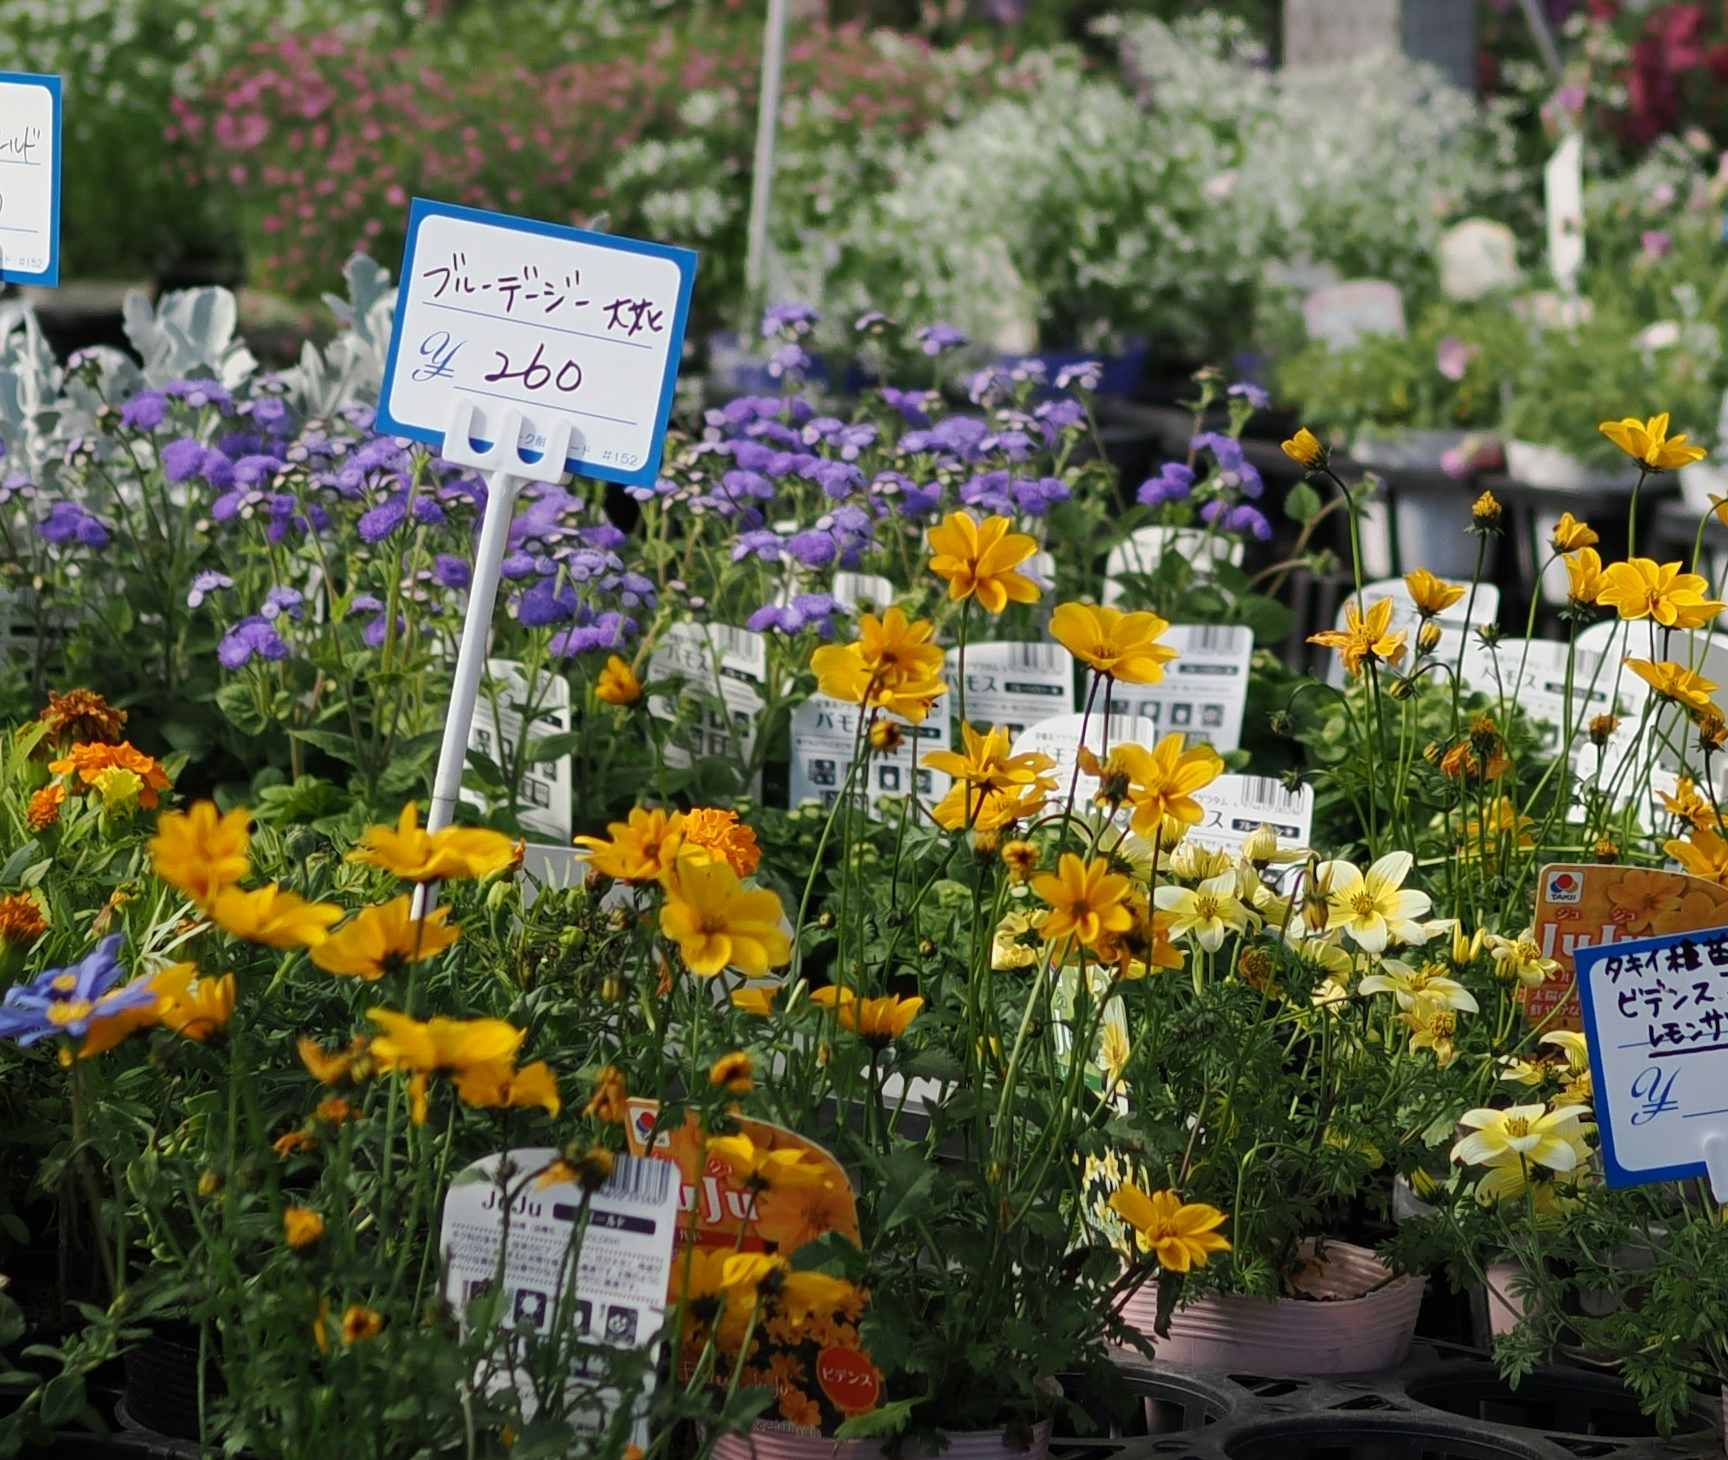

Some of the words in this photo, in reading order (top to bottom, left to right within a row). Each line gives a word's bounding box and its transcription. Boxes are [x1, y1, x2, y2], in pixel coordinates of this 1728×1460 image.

[19, 258, 43, 269] #152
[423, 252, 590, 313] ブルーデージー
[484, 343, 582, 392] 260
[603, 450, 639, 467] #152
[1618, 980, 1714, 1019] ビデンス
[822, 1366, 873, 1388] ビデンス
